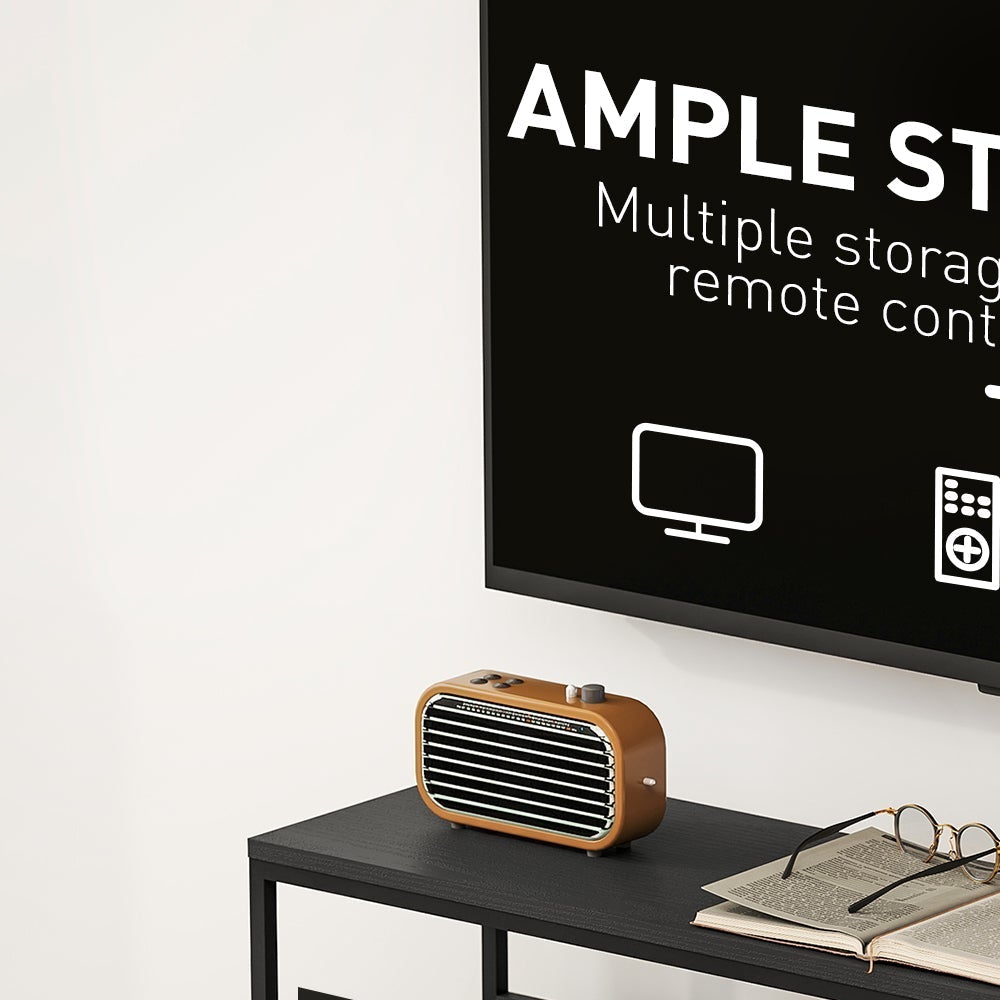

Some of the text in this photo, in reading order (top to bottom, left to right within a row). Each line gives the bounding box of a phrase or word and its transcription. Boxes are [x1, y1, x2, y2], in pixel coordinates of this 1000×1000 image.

[506, 62, 856, 192] AMPLE
[598, 180, 813, 264] Multiple
[669, 264, 860, 326] remote
